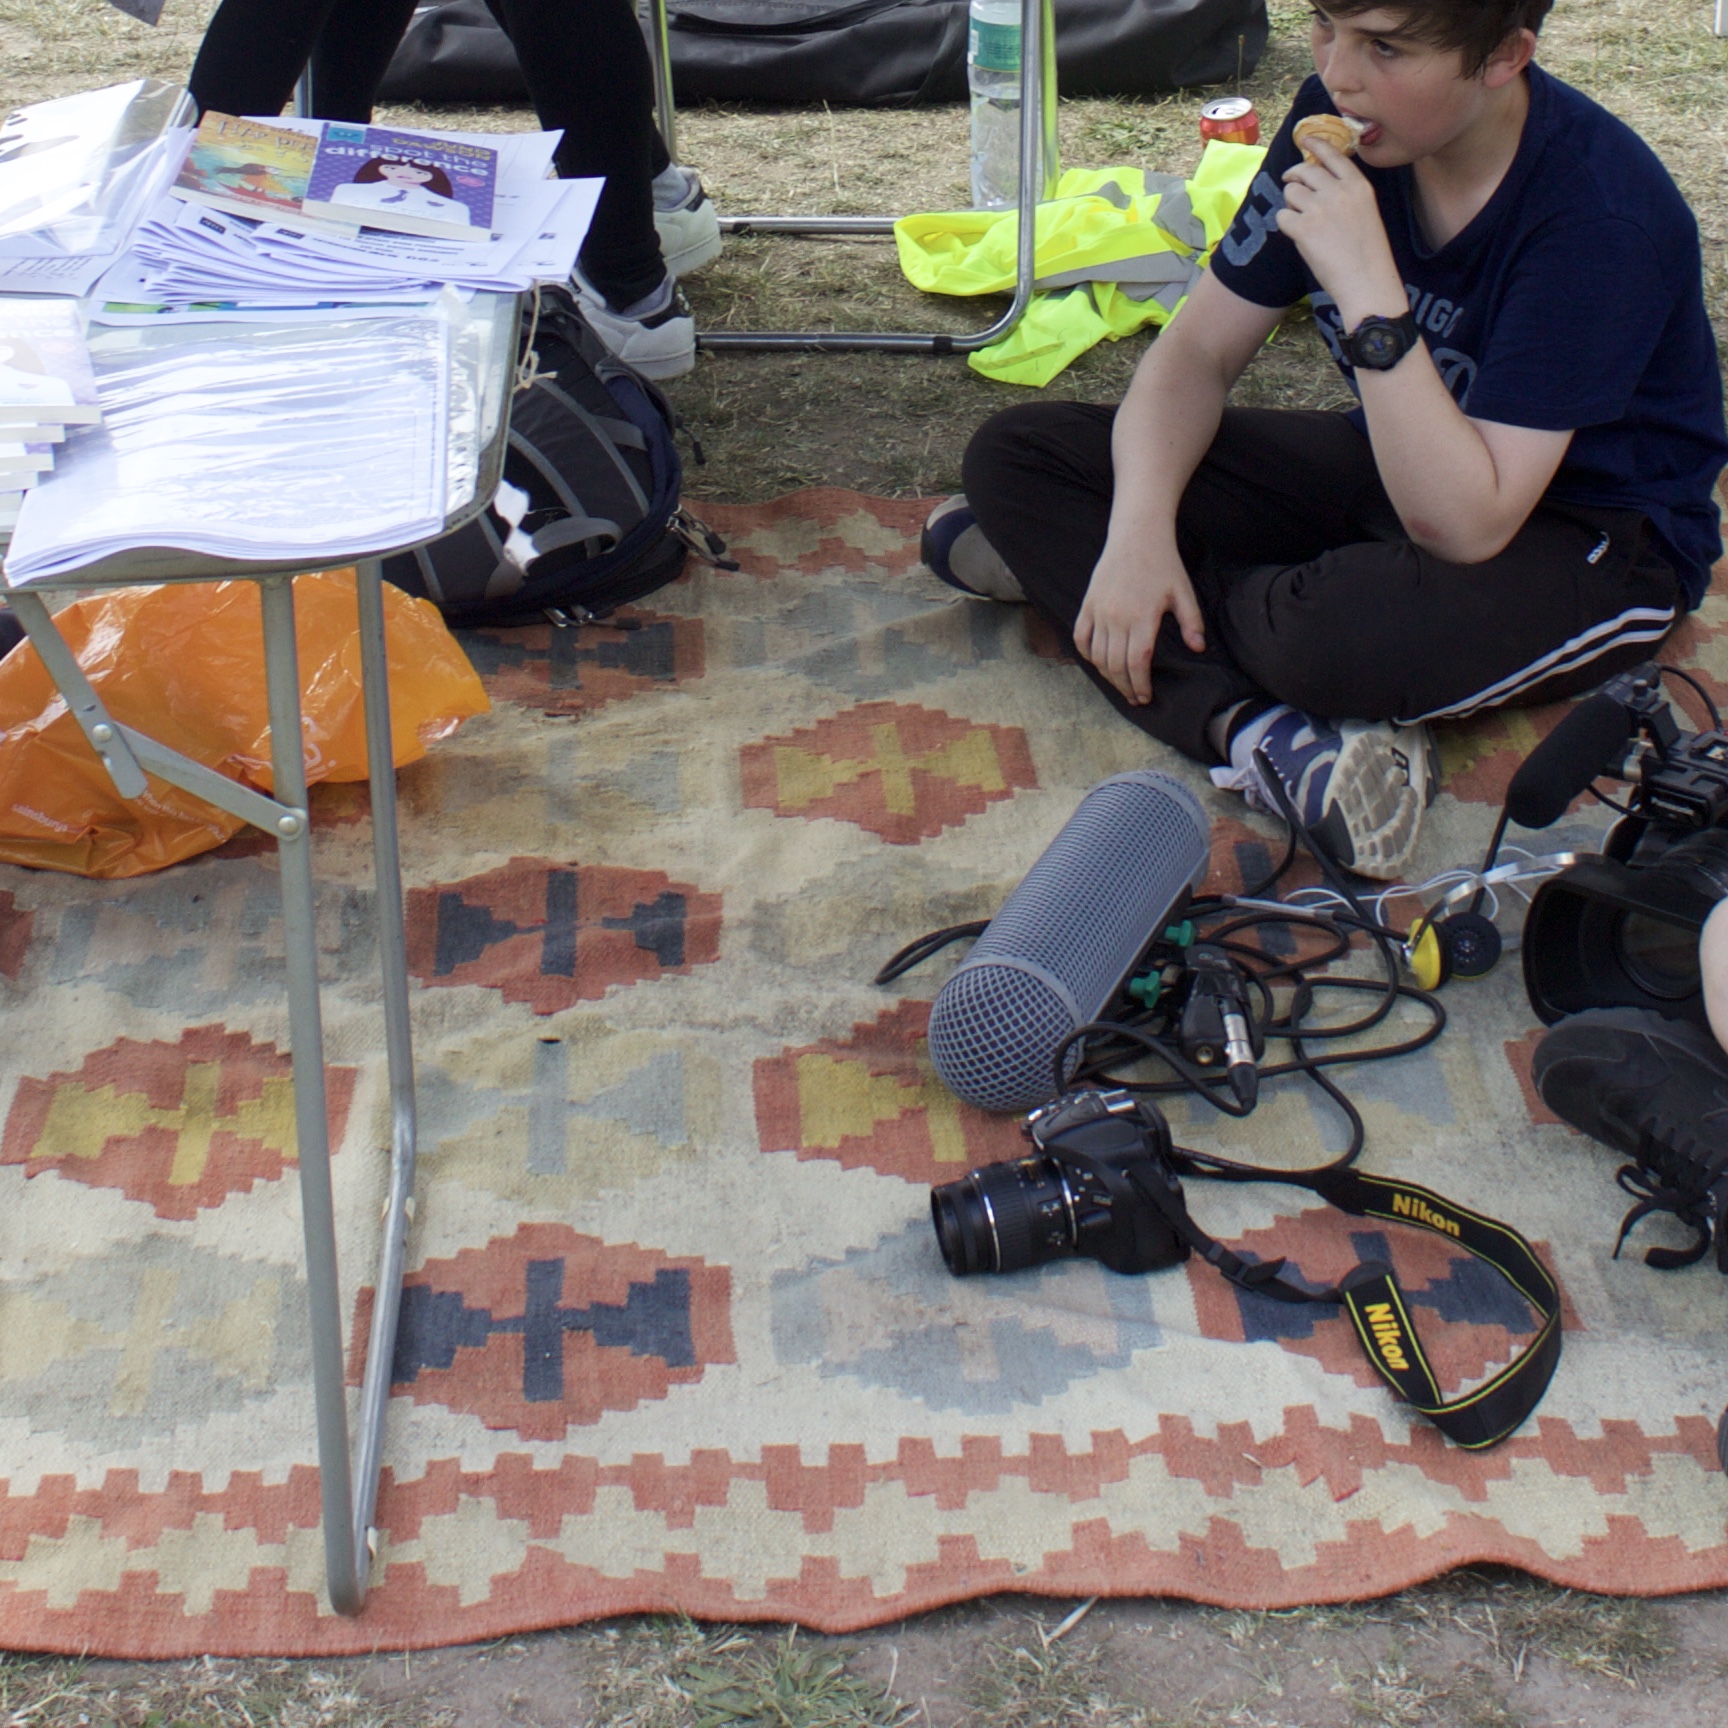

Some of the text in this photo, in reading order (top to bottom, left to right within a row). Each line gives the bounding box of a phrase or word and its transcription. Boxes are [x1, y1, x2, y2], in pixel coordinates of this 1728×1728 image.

[323, 146, 490, 177] difference
[442, 153, 488, 169] the
[1392, 1192, 1461, 1238] Nikon
[1363, 1302, 1410, 1371] Nikon
